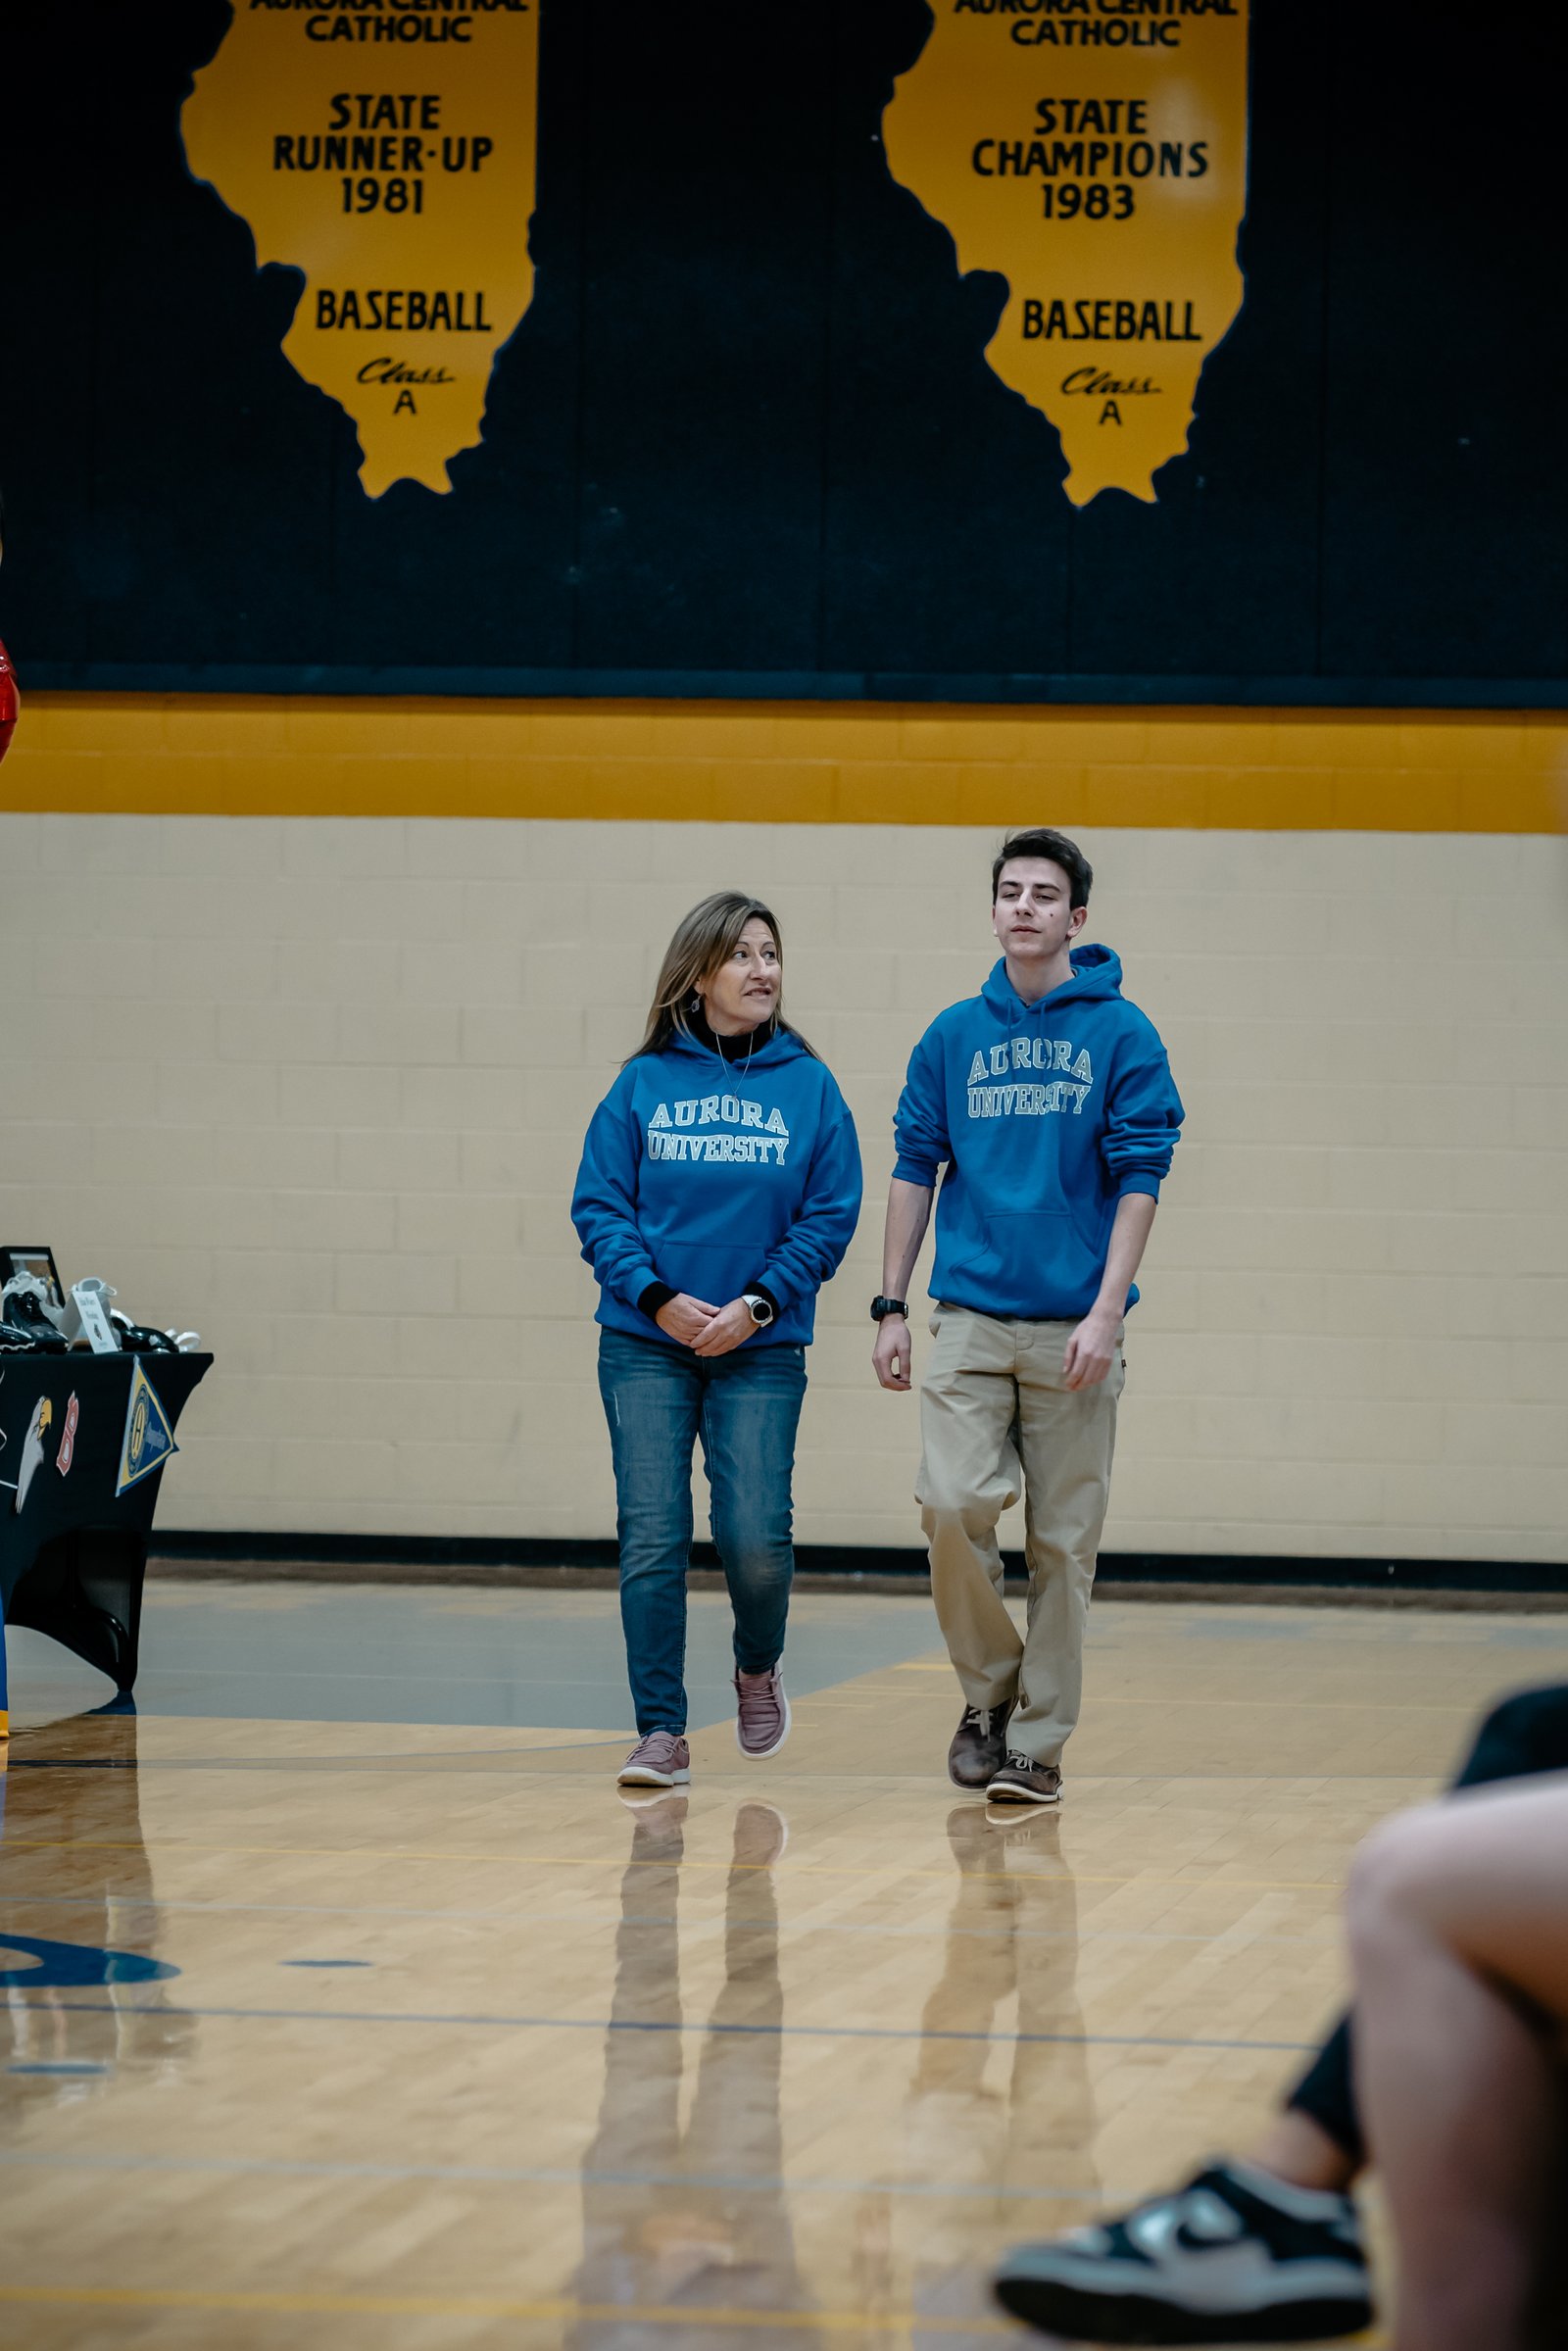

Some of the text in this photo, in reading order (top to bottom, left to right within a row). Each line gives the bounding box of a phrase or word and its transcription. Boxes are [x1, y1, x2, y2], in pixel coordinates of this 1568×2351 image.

[305, 14, 472, 43] CATHOLIC
[1010, 18, 1181, 47] CATHOLIC
[328, 92, 440, 131] STATE
[1034, 97, 1147, 136] STATE
[273, 134, 493, 173] RUNNER-UP
[971, 138, 1208, 178] CHAMPIONS
[342, 176, 423, 215] 1981
[1042, 182, 1135, 220] 1983
[316, 289, 492, 332] BASEBALL
[1022, 299, 1202, 342] BASEBALL
[357, 357, 454, 385] Class
[1060, 367, 1159, 395] Class
[393, 389, 416, 415] A
[1099, 399, 1122, 425] A
[967, 1037, 1094, 1086] AURORA
[648, 1094, 789, 1137] AURORA
[967, 1081, 1092, 1118] UNIVERSITY
[648, 1129, 789, 1166] UNIVERSITY
